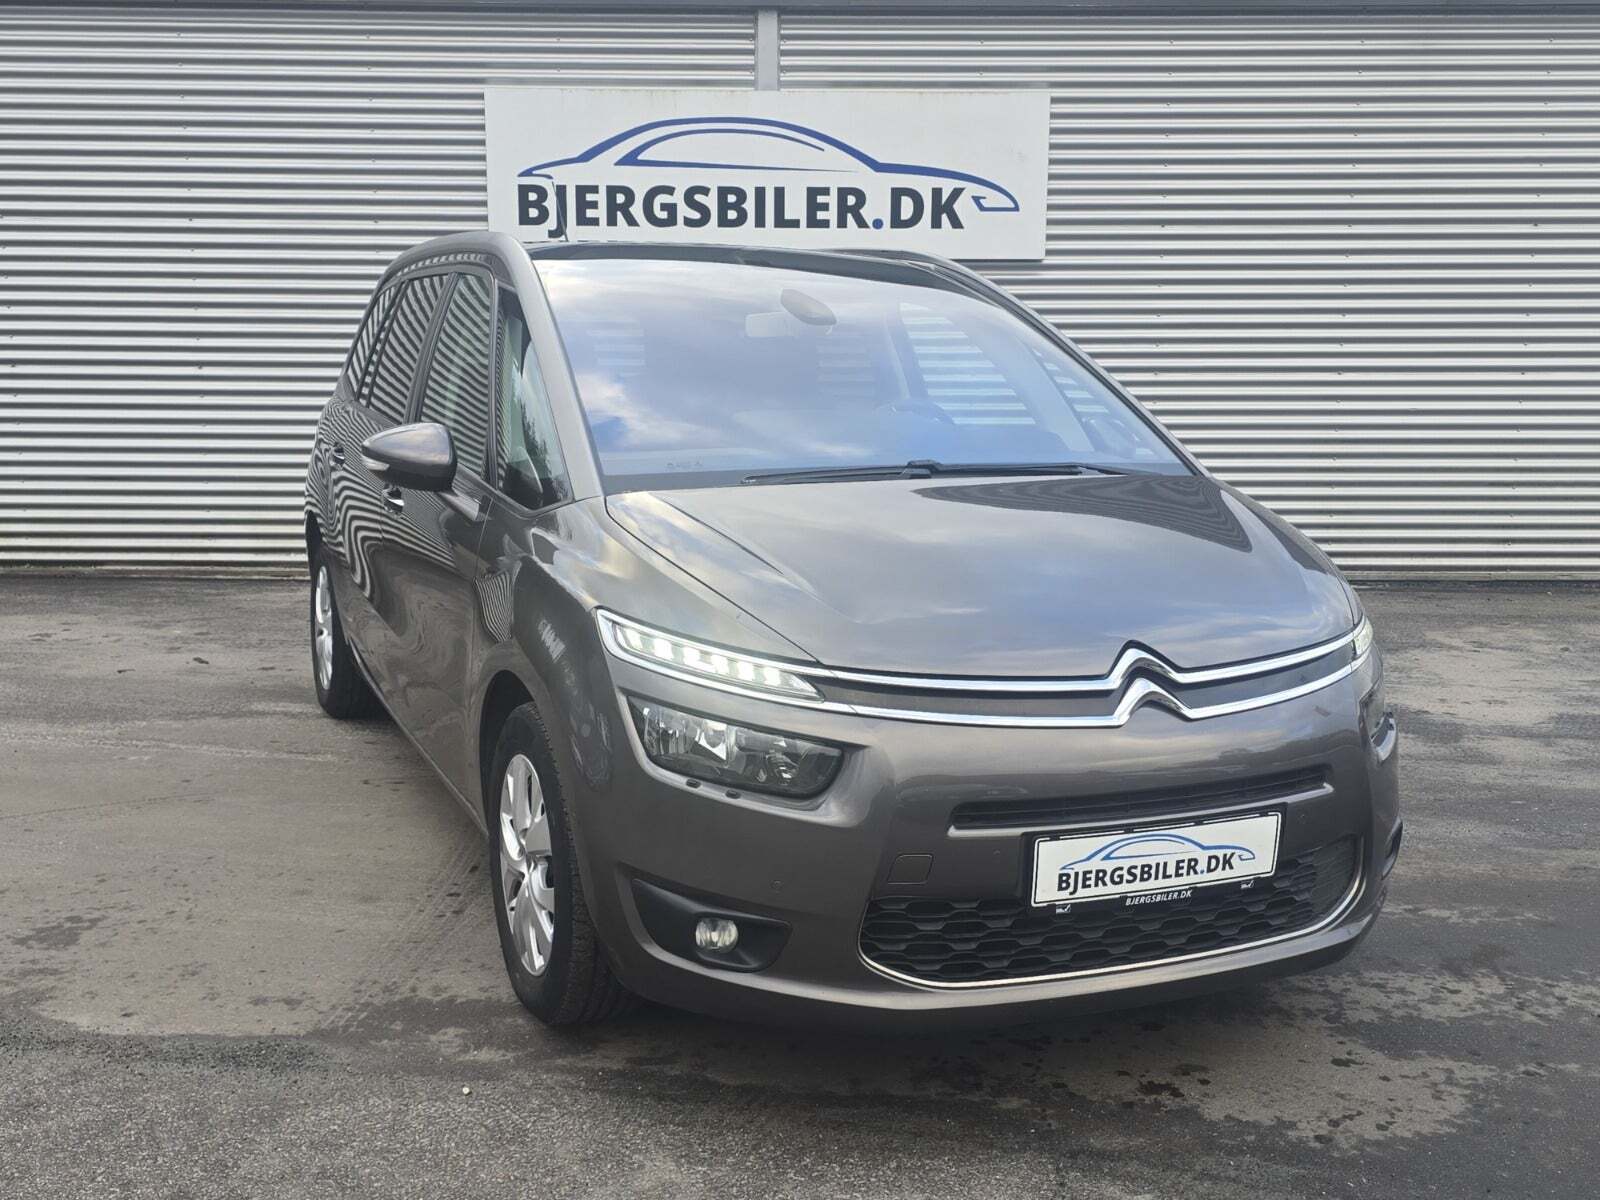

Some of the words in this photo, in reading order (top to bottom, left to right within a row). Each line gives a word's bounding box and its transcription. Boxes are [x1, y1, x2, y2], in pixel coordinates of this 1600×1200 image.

[518, 183, 966, 238] BJERGSBILER.DK
[1057, 852, 1236, 895] BJERGSBILER.DK
[1125, 889, 1193, 906] BJERGSBILER.DK
